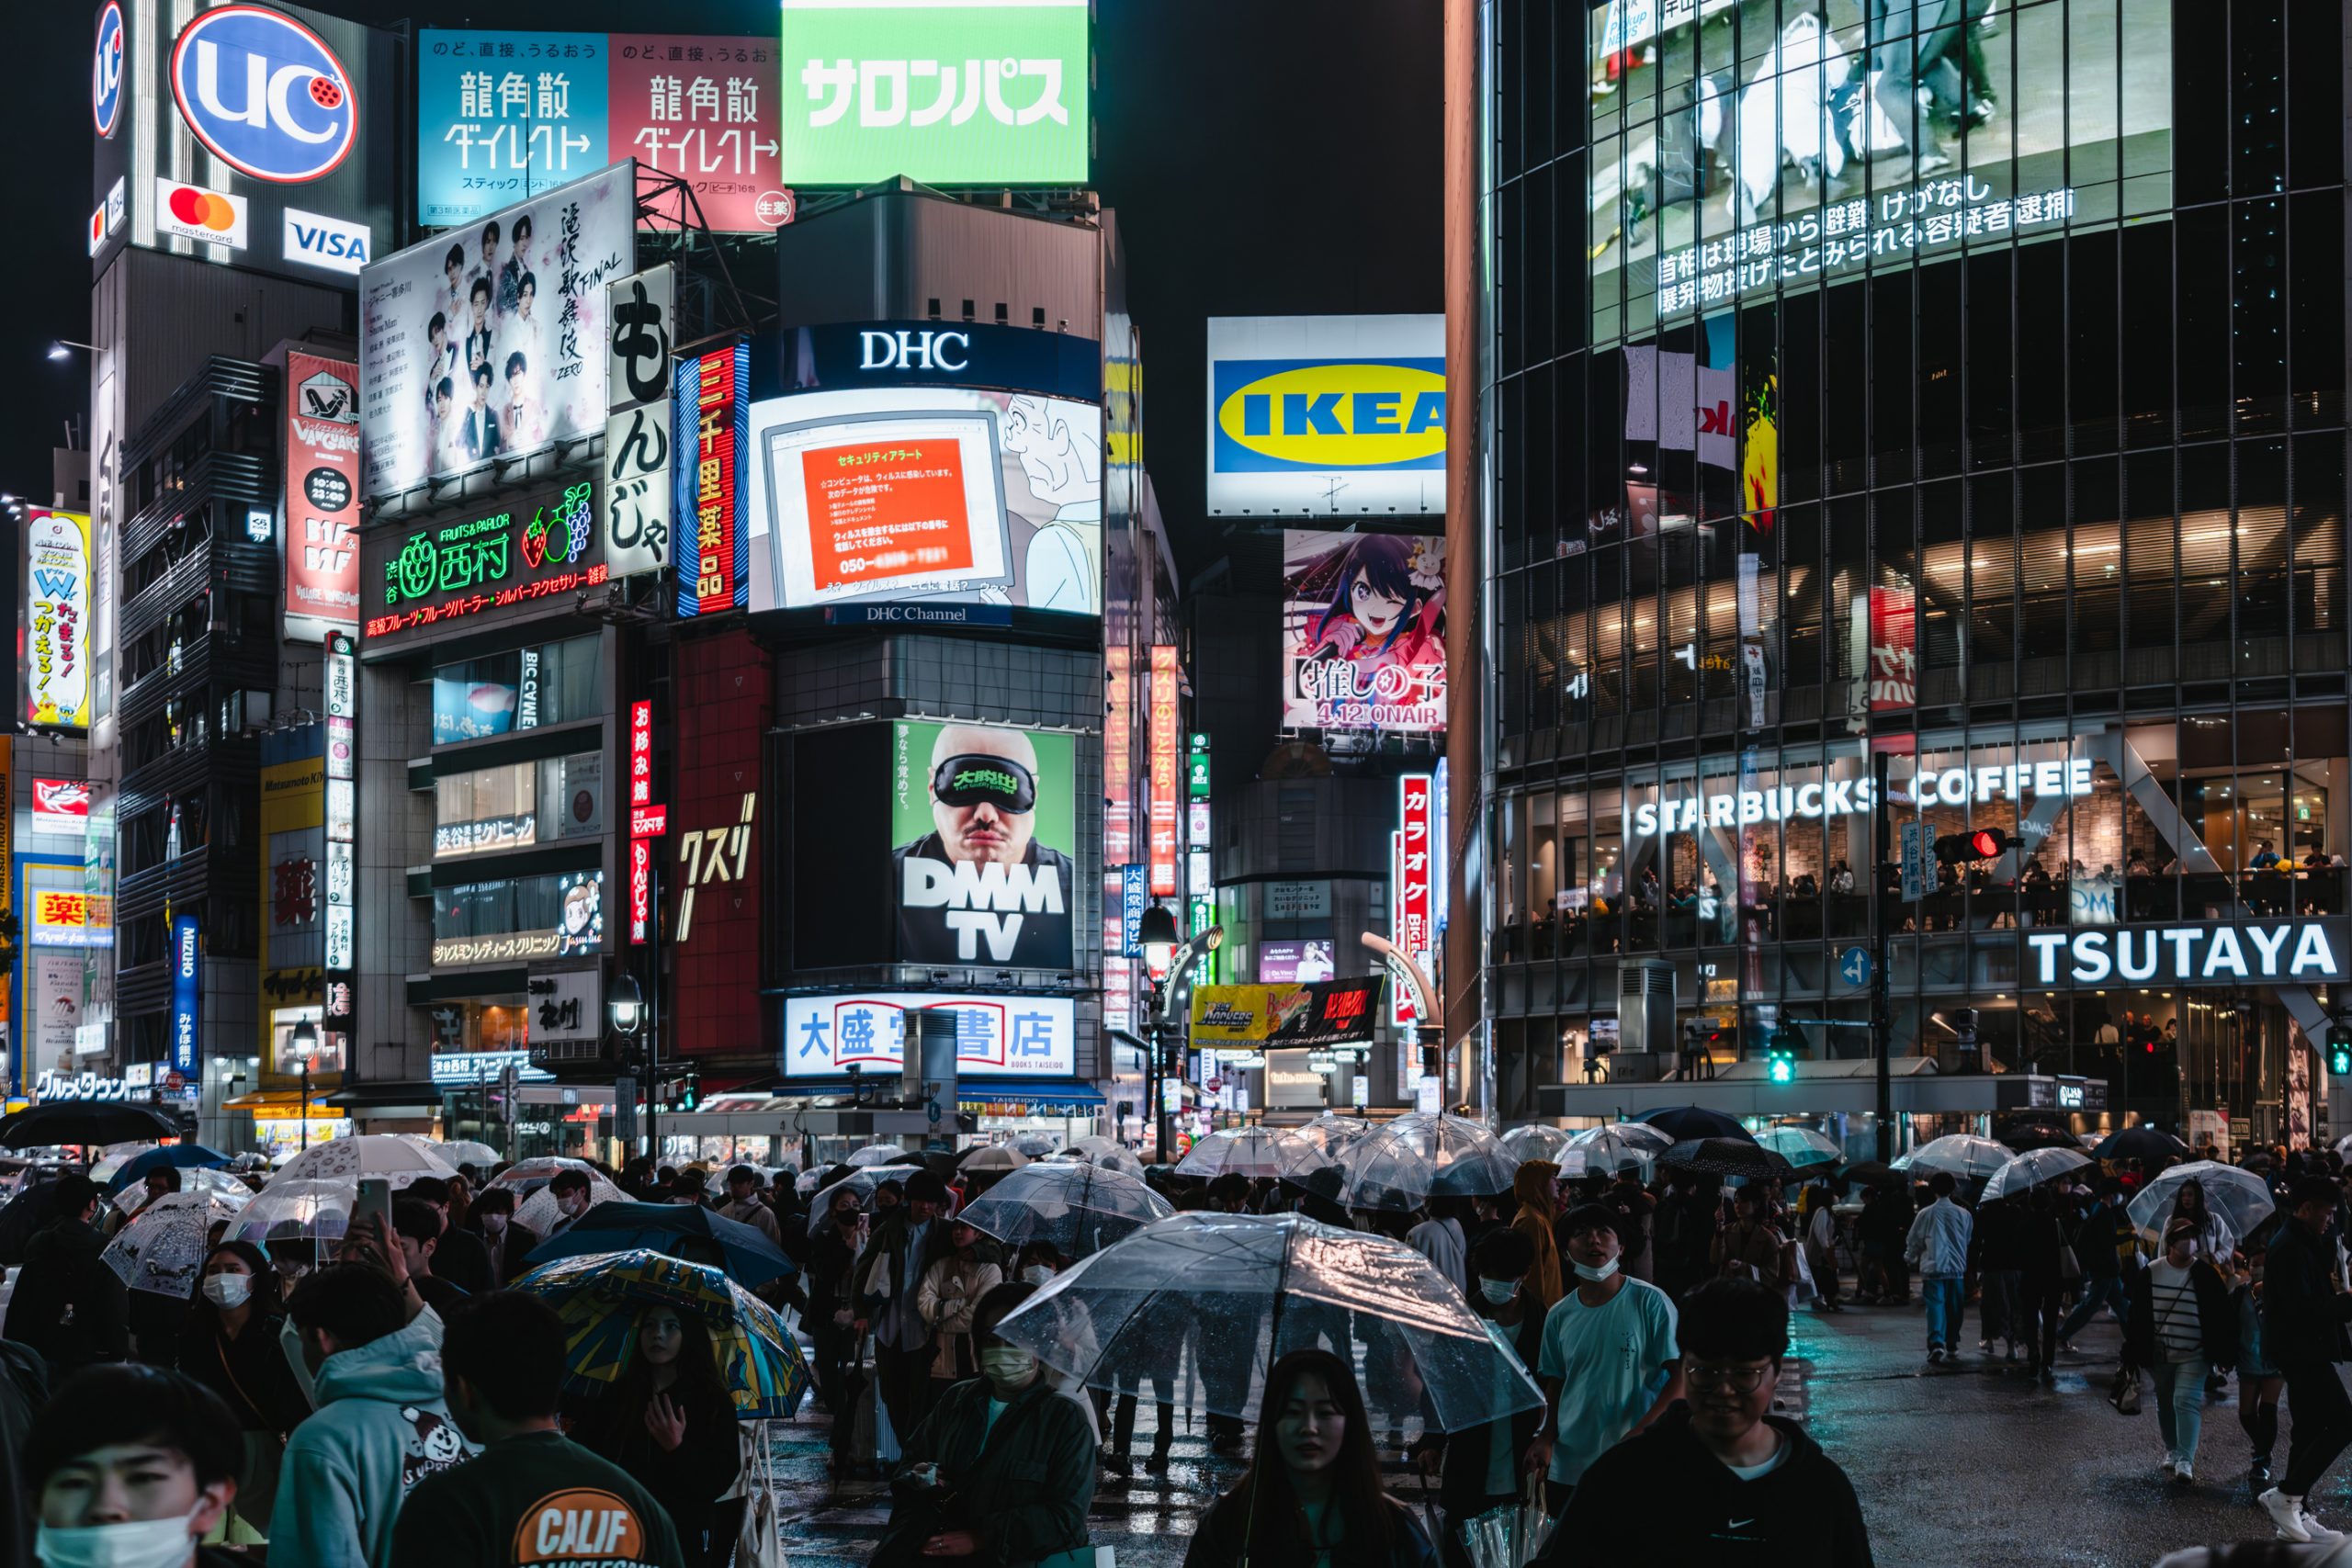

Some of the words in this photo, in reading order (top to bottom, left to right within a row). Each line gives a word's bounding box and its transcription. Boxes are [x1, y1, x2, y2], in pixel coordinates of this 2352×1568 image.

[433, 41, 596, 60] のど、直接、うるおう
[460, 71, 571, 120] 龍角散
[650, 74, 759, 124] 龍角散
[801, 57, 1069, 128] サロンパス
[444, 124, 591, 171] ダイレクト
[633, 127, 780, 175] ダイレクト
[463, 176, 518, 190] スティック
[711, 184, 736, 193] ピーチ
[738, 184, 756, 193] 16包
[1881, 174, 1991, 224] けがなし
[758, 200, 788, 216] 生薬
[171, 224, 233, 244] mastercard
[288, 221, 368, 263] VISA
[579, 251, 623, 297] FINAL
[557, 361, 583, 381] ZERO
[859, 331, 969, 370] DHC
[611, 279, 670, 562] もんじゃ
[1243, 390, 1446, 436] IKEA
[697, 358, 724, 599] 三千里薬品
[837, 448, 923, 468] セキュリティアラート
[305, 517, 351, 547] B1F
[440, 513, 511, 543] FRUITS&PARLOR
[833, 537, 895, 554] 電話してください。
[304, 545, 353, 575] B2F
[385, 560, 399, 604] 渋谷
[438, 533, 510, 592] 西村
[866, 606, 902, 622] DHC
[904, 606, 967, 623] Channel
[634, 706, 650, 801] お好み焼
[896, 723, 910, 811] 夢なら覚めて。
[952, 768, 1018, 788] 大脱出
[1909, 758, 2094, 807] COFFEE
[1635, 776, 1878, 837] STARBUCKS
[1405, 791, 1428, 902] カラオケ
[1909, 828, 1919, 895] 渋谷駅前
[902, 855, 1066, 915] DMM
[1125, 868, 1142, 955] 大盛堂商事ビル
[182, 926, 195, 978] MIZUHO
[433, 934, 560, 963] ジャスミンレディースクリニック
[560, 932, 603, 955] Jasmine
[945, 908, 1024, 962] TV
[2028, 923, 2338, 984] TSUTAYA
[1197, 1001, 1254, 1026] ROCKERS
[178, 1013, 192, 1068] みずほ銀行
[36, 1067, 126, 1101] グルメタウン
[433, 1058, 470, 1073] 渋谷西村
[1011, 1060, 1033, 1069] BOOKS
[1034, 1060, 1064, 1070] TAISEIDO
[991, 1096, 1039, 1104] TAISEIDO
[536, 1507, 628, 1556] CALIF
